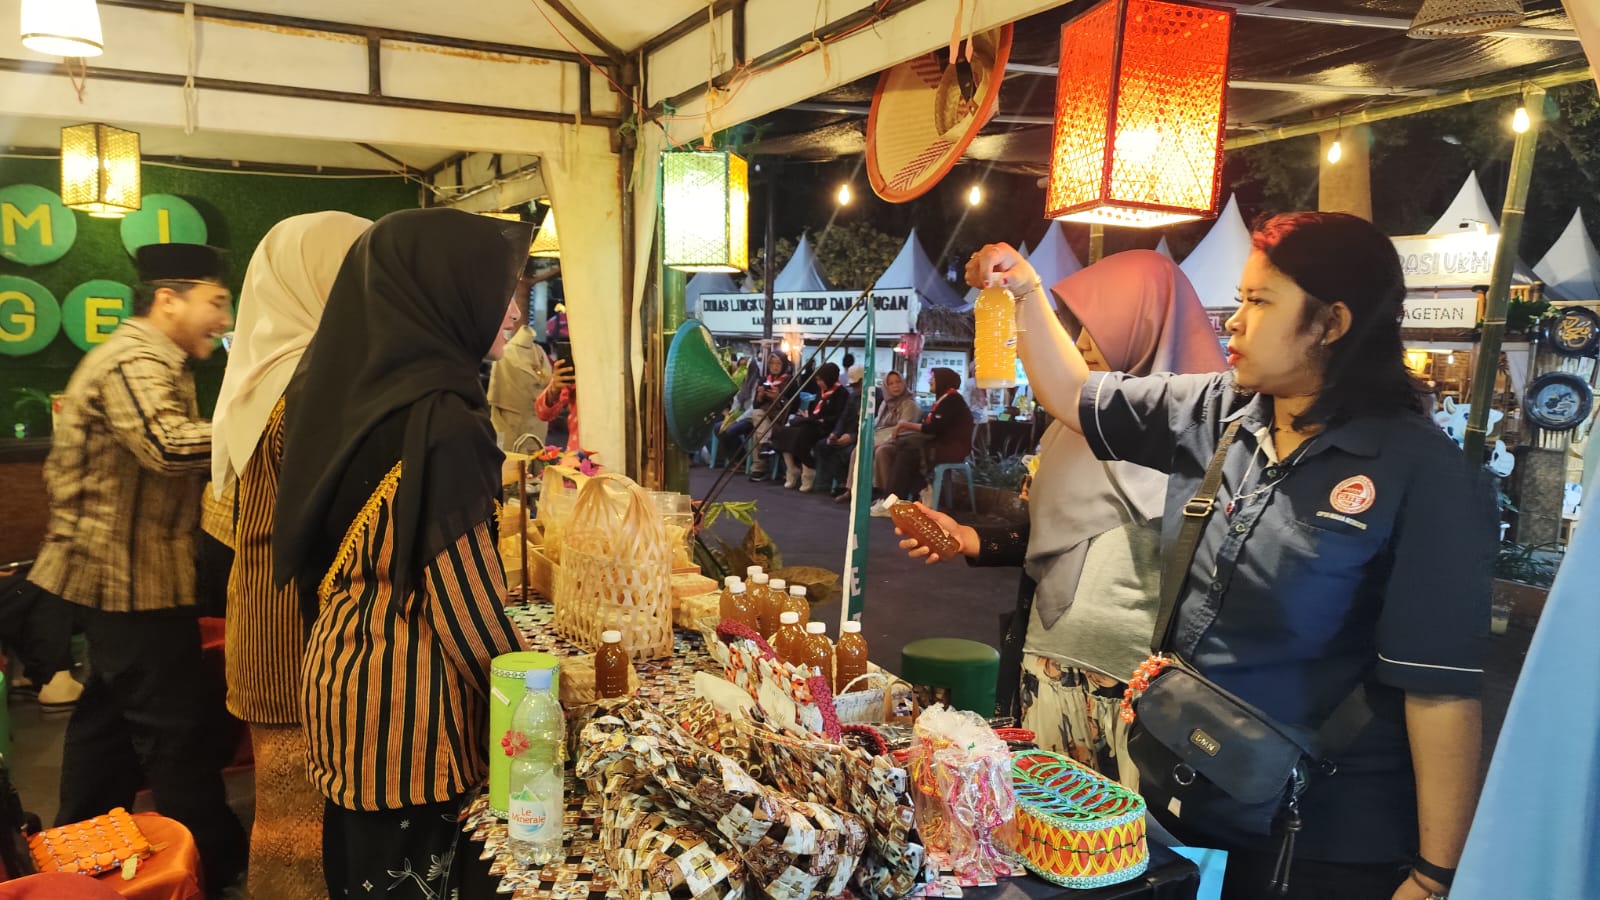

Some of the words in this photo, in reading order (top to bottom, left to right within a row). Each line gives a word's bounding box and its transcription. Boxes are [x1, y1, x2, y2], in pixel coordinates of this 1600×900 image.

[703, 299, 729, 312] DINAS
[730, 297, 794, 312] LINGKUGAN
[796, 297, 827, 311] HIDUP
[829, 296, 851, 311] DAN
[752, 316, 792, 326] KABATEN
[796, 315, 833, 326] MAGETAN
[1402, 307, 1464, 321] AGETAN
[512, 811, 545, 824] Minerale
[522, 808, 532, 817] Le
